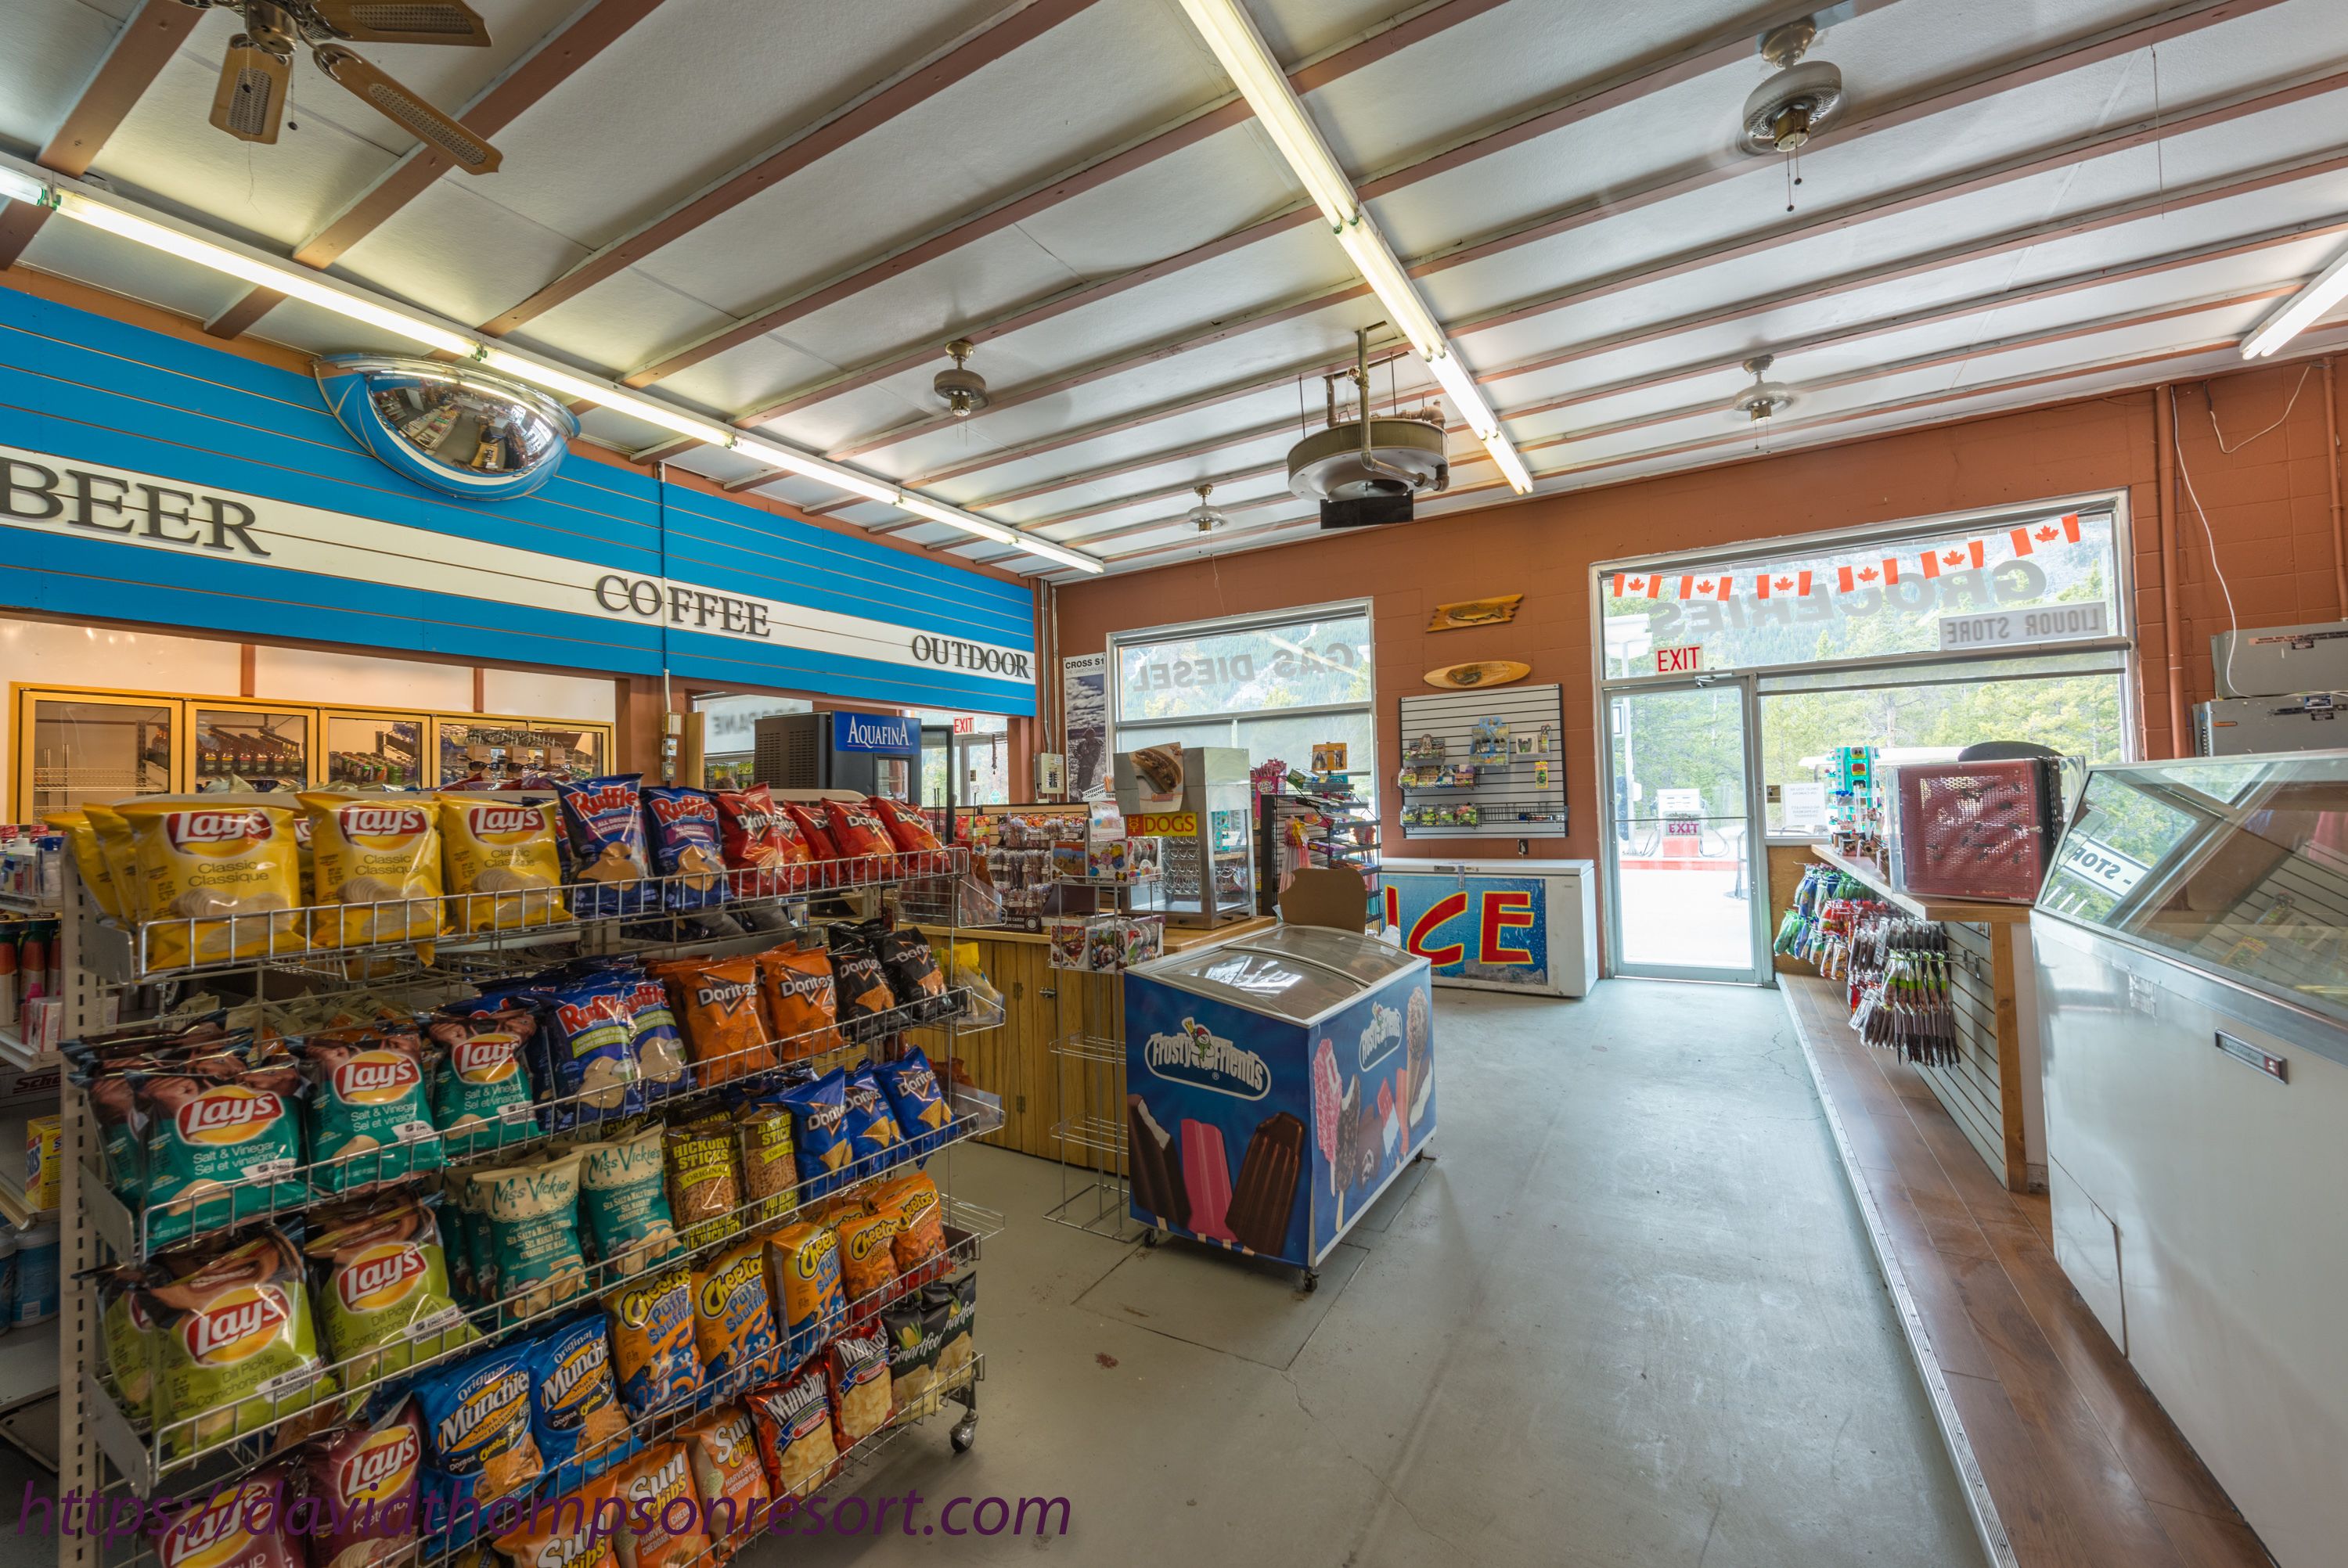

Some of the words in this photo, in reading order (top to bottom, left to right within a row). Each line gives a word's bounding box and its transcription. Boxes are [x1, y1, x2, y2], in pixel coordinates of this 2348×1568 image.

[0, 457, 271, 556] BEER
[596, 574, 771, 637] COFFEE
[912, 635, 1031, 678] OUTDOOR
[1065, 659, 1093, 670] CROSS
[1658, 646, 1700, 671] EXIT
[954, 717, 974, 733] EXIT
[1144, 815, 1194, 833] DOGS
[1669, 823, 1699, 833] EXIT
[198, 860, 257, 874] Classic
[363, 854, 412, 865] Classic
[188, 872, 268, 886] Classique
[1385, 885, 1534, 967] ICE
[699, 983, 757, 1005] Doritos
[1151, 1033, 1193, 1067] Frosty
[1213, 1036, 1263, 1091] Friends
[351, 1110, 370, 1121] Salt
[383, 1103, 415, 1114] Vinega
[808, 1104, 846, 1131] Dorito
[353, 1121, 369, 1132] Sel
[762, 1125, 791, 1145] STICK
[193, 1151, 217, 1164] Salt
[219, 1149, 229, 1159] &
[232, 1141, 275, 1156] Vinegar
[672, 1137, 731, 1158] HICKORY
[195, 1163, 214, 1175] Sel
[217, 1160, 229, 1171] et
[679, 1149, 729, 1170] STICKS
[798, 1228, 841, 1280] Cheet
[621, 1266, 691, 1329] Cheetos
[554, 1329, 593, 1364] Original
[242, 1354, 274, 1374] Pickle
[458, 1364, 507, 1401] Original
[439, 1370, 529, 1455] Munchie
[715, 1414, 751, 1465] Sun
[729, 1434, 754, 1469] Chip
[628, 1453, 685, 1520] Sun
[639, 1525, 666, 1546] HARVE
